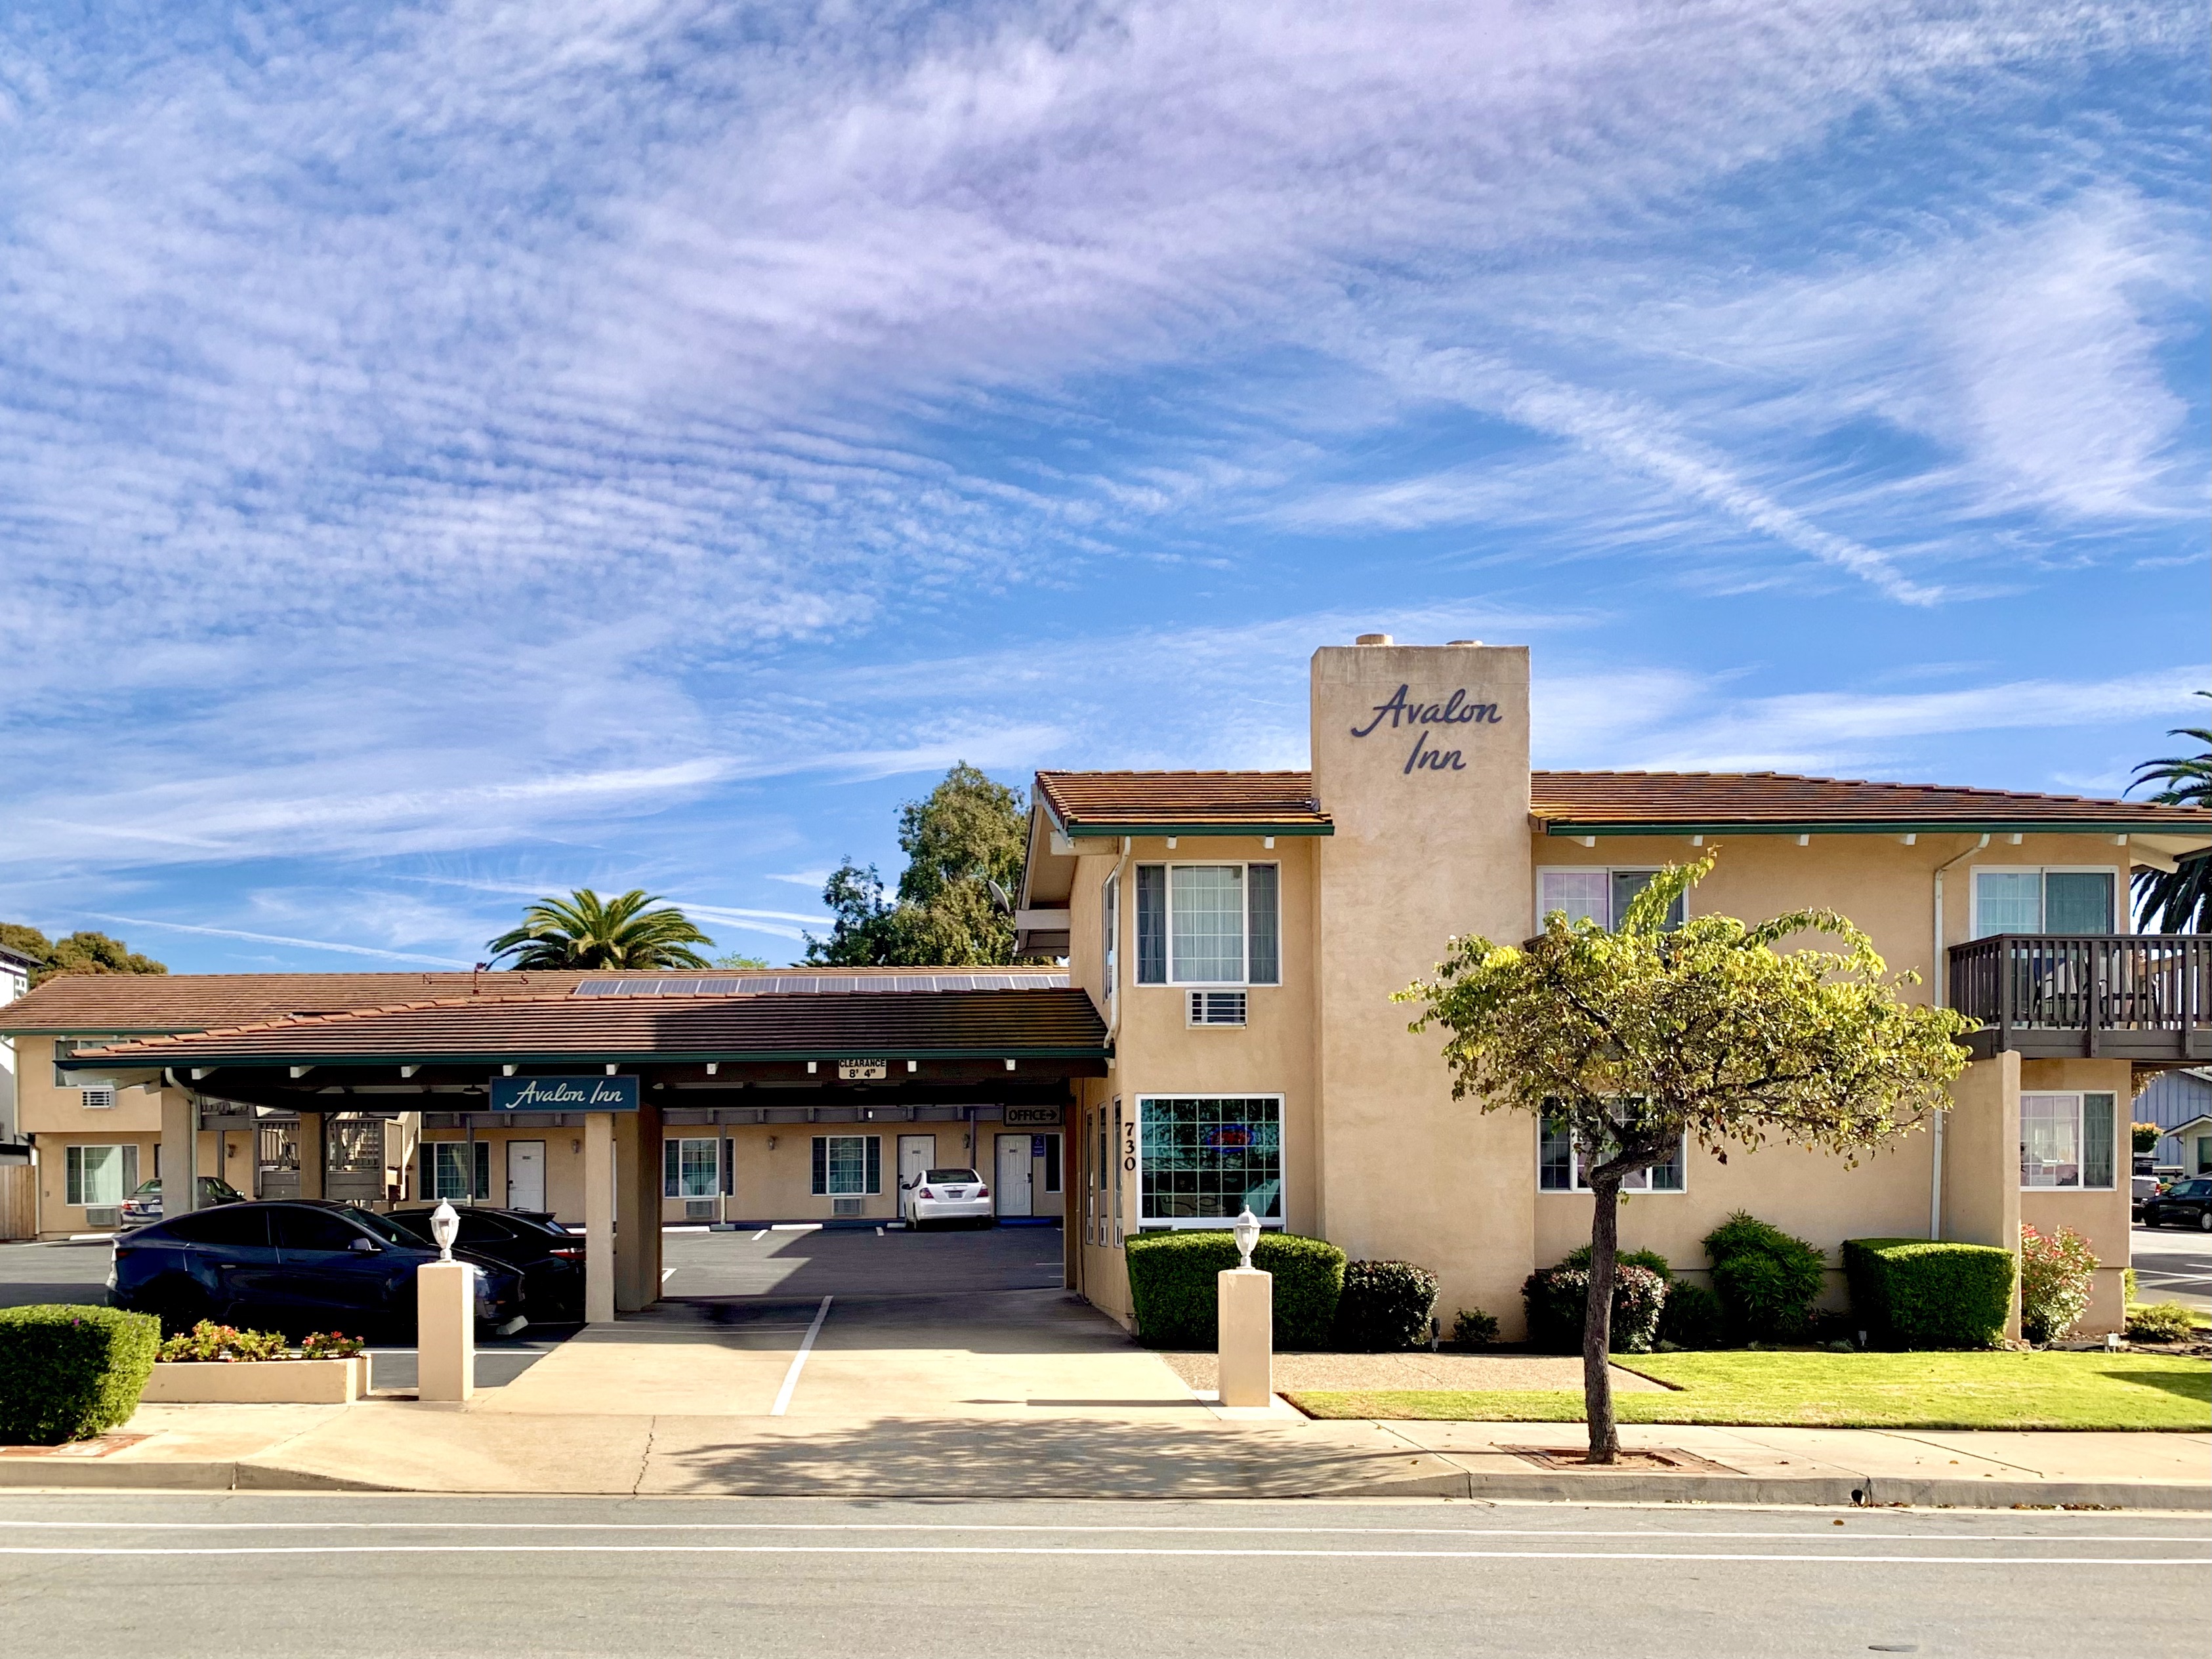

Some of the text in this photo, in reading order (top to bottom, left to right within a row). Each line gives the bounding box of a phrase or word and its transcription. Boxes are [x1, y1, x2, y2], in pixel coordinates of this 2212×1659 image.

[1350, 684, 1502, 737] Avalon
[1404, 730, 1467, 774] Inn
[839, 1059, 885, 1068] CLEARANCE
[505, 1080, 623, 1109] Avalon Inn
[1008, 1109, 1047, 1121] OFFICE
[1124, 1122, 1136, 1171] 730
